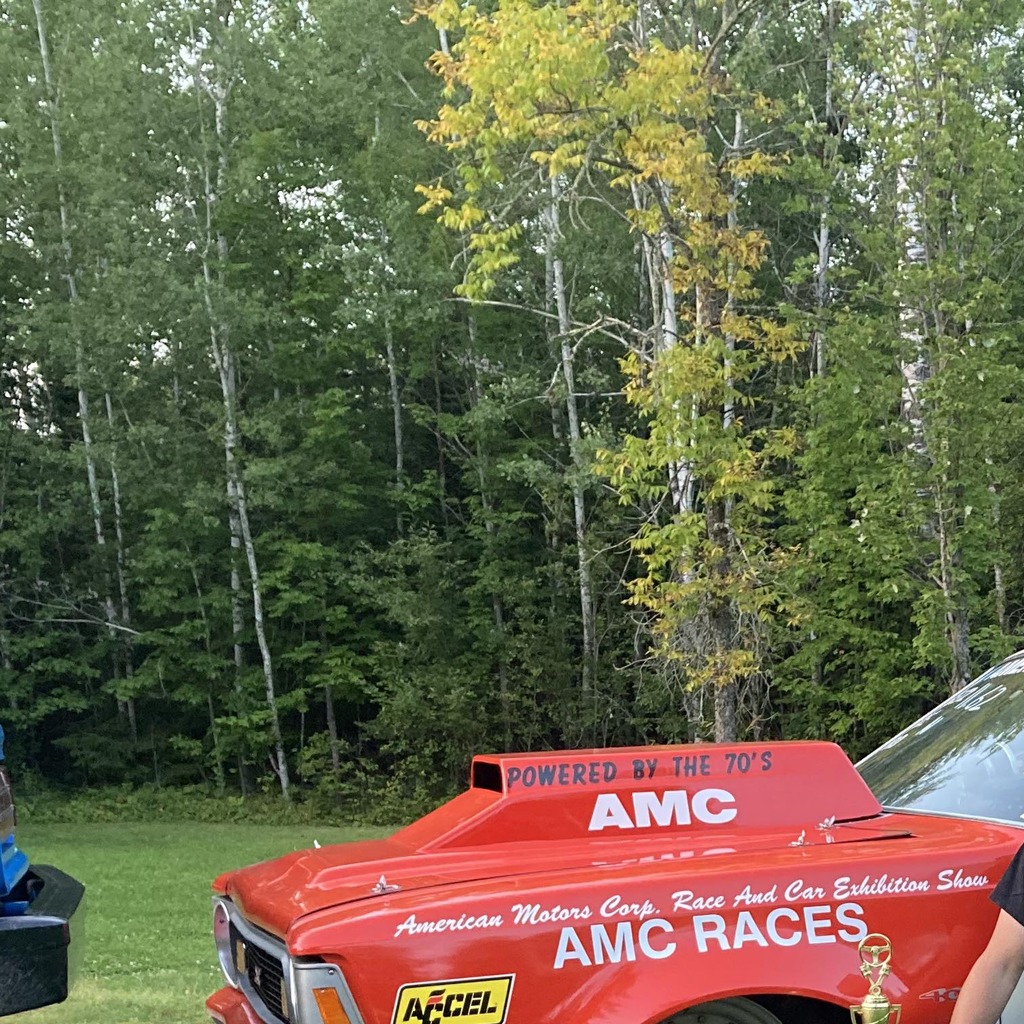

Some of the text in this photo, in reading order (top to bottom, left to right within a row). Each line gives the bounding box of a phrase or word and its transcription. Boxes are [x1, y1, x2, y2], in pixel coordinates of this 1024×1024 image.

[507, 750, 773, 788] POWERED BY THE 70'S
[588, 788, 738, 832] AMC
[394, 868, 989, 938] American Motors Corp. Race And Car Exhibition Show
[553, 902, 868, 969] AMC RACES
